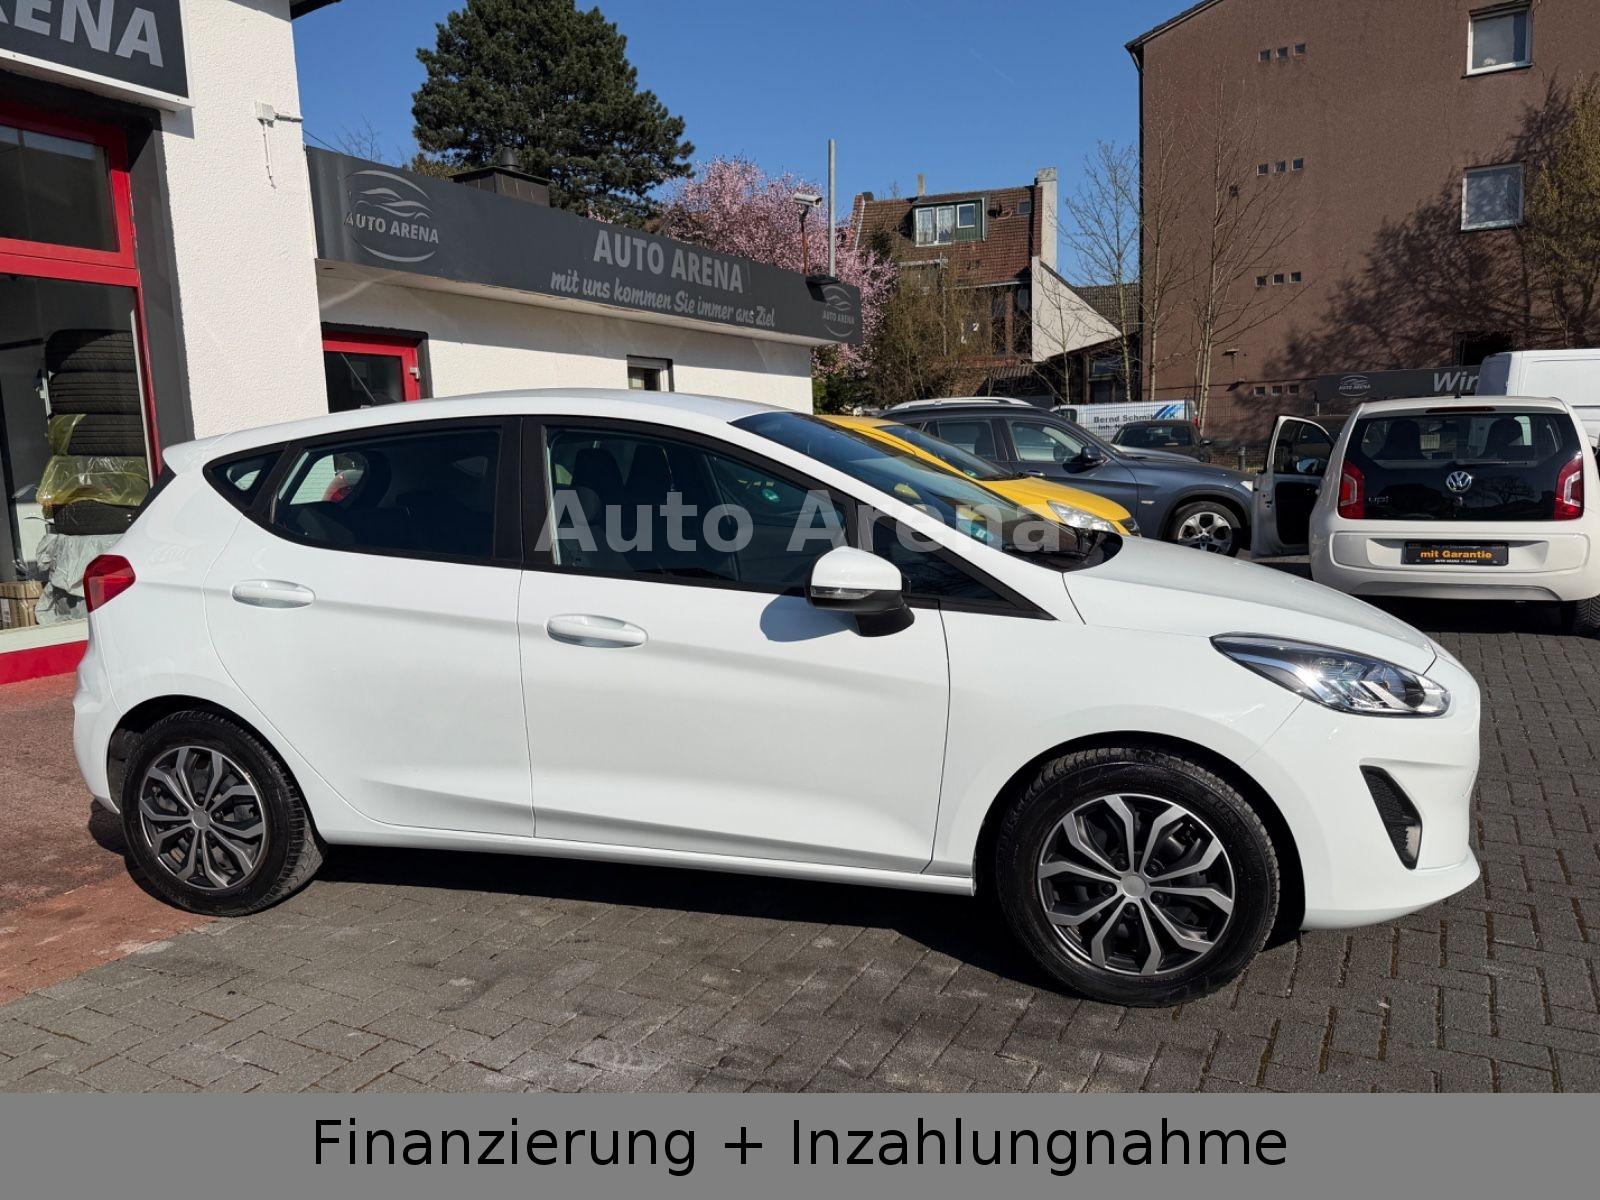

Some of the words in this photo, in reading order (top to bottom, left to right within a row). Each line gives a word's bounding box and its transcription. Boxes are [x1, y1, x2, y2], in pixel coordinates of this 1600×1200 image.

[0, 0, 163, 67] ENA
[344, 212, 387, 233] AUTO
[390, 220, 439, 244] ARENA
[593, 229, 664, 275] AUTO
[671, 248, 744, 294] ARENA
[550, 269, 580, 293] mit
[583, 277, 611, 299] uns
[613, 277, 671, 310] kommen
[674, 290, 696, 314] Sie
[697, 296, 734, 320] immer
[755, 305, 776, 328] Ziel
[1433, 371, 1480, 392] Wir
[1093, 415, 1120, 424] Bernd
[1420, 550, 1439, 558] mit
[1442, 550, 1493, 559] Garantie
